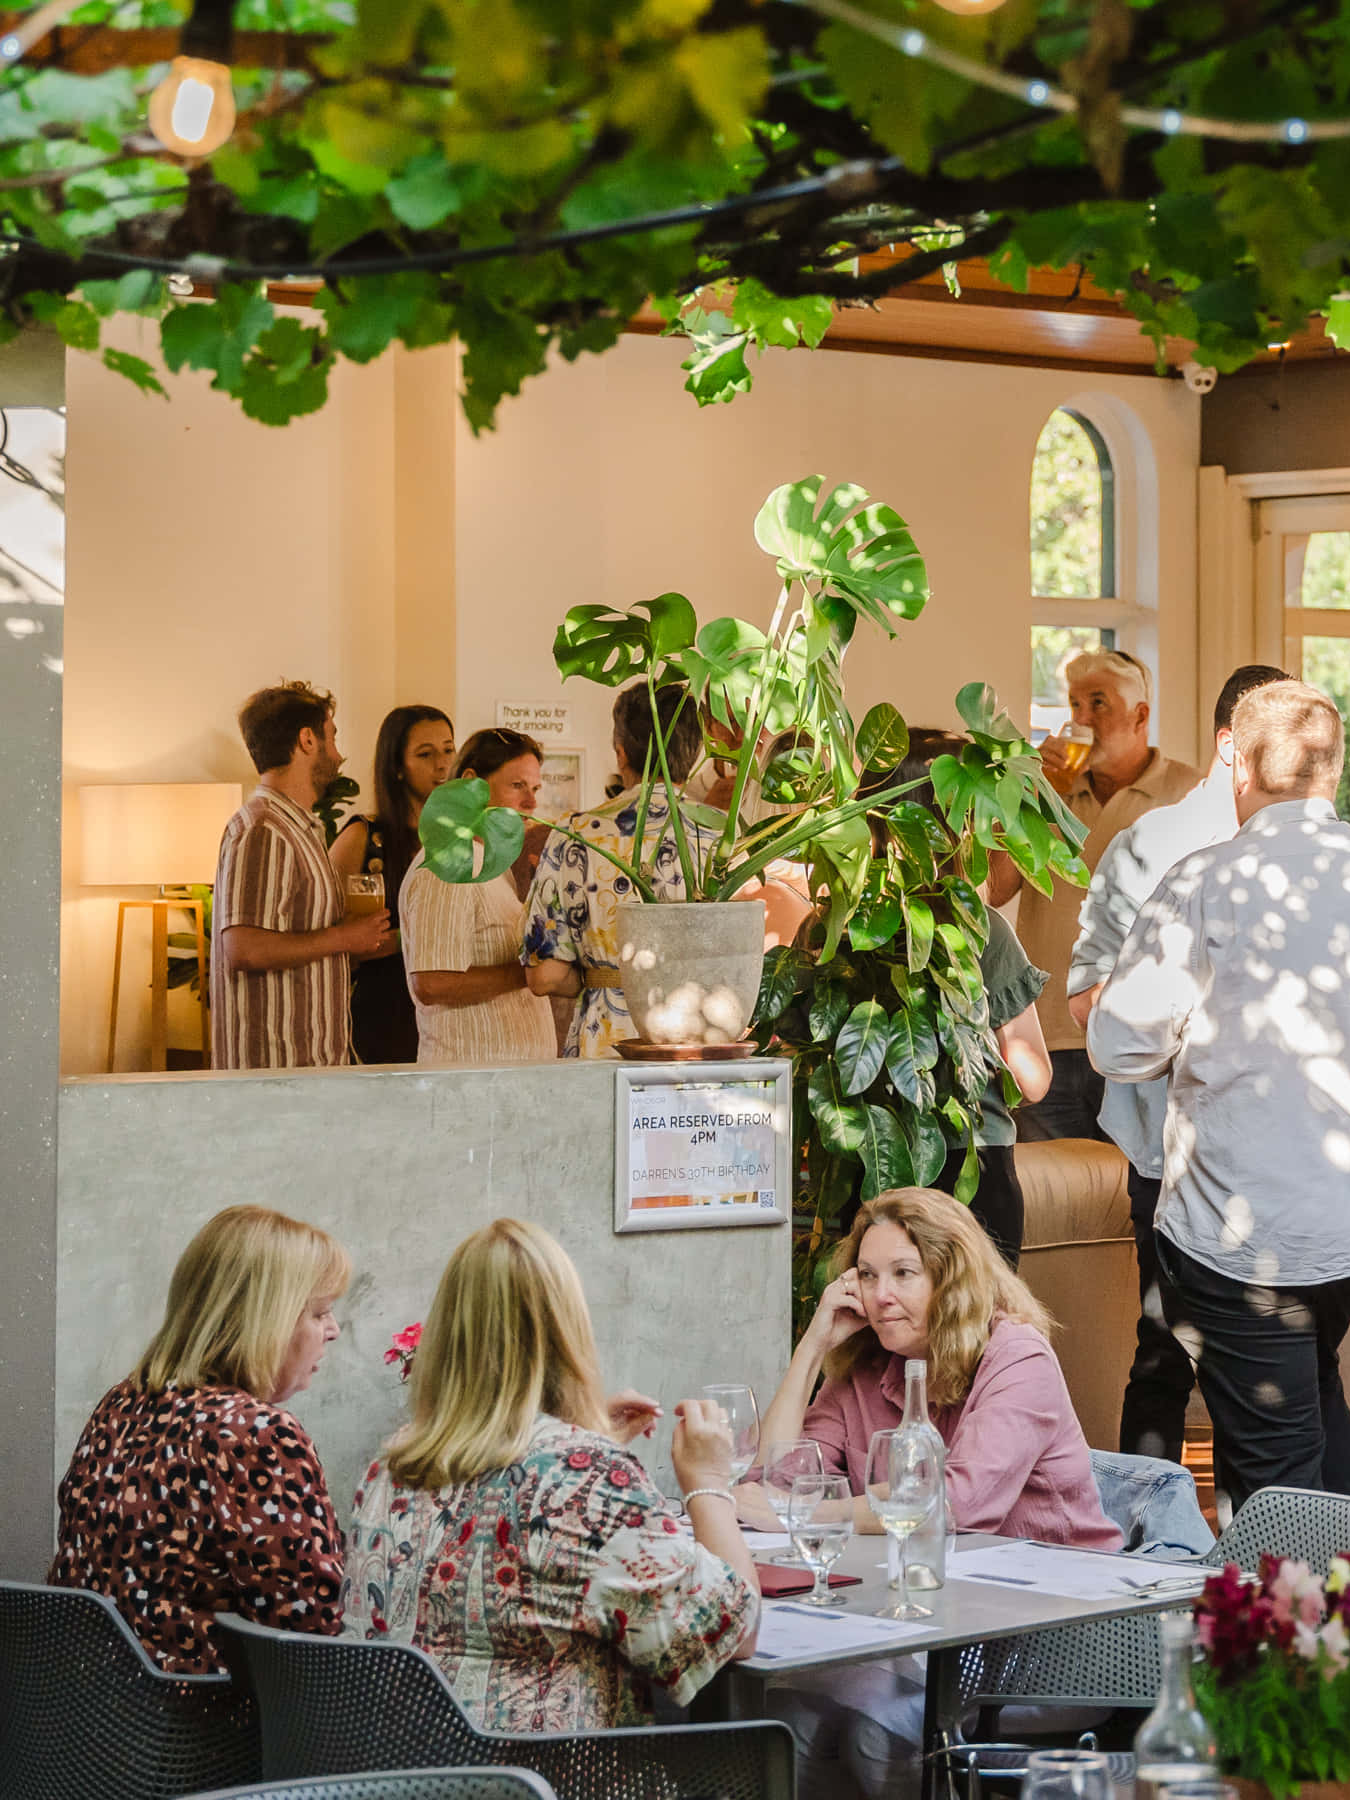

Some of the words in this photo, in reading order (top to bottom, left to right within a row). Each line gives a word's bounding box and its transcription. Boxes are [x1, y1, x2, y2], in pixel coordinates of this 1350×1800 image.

[504, 706, 530, 718] Thank
[535, 709, 552, 719] you
[555, 708, 567, 718] for
[505, 721, 521, 730] not
[524, 721, 564, 733] smoking
[633, 1117, 666, 1130] AREA
[670, 1114, 734, 1128] RESERVED
[737, 1113, 772, 1126] FROM
[690, 1131, 716, 1145] 4PM
[633, 1168, 685, 1182] DARREN'S
[688, 1166, 714, 1180] 30TH
[718, 1164, 770, 1178] BIRTHDAY
